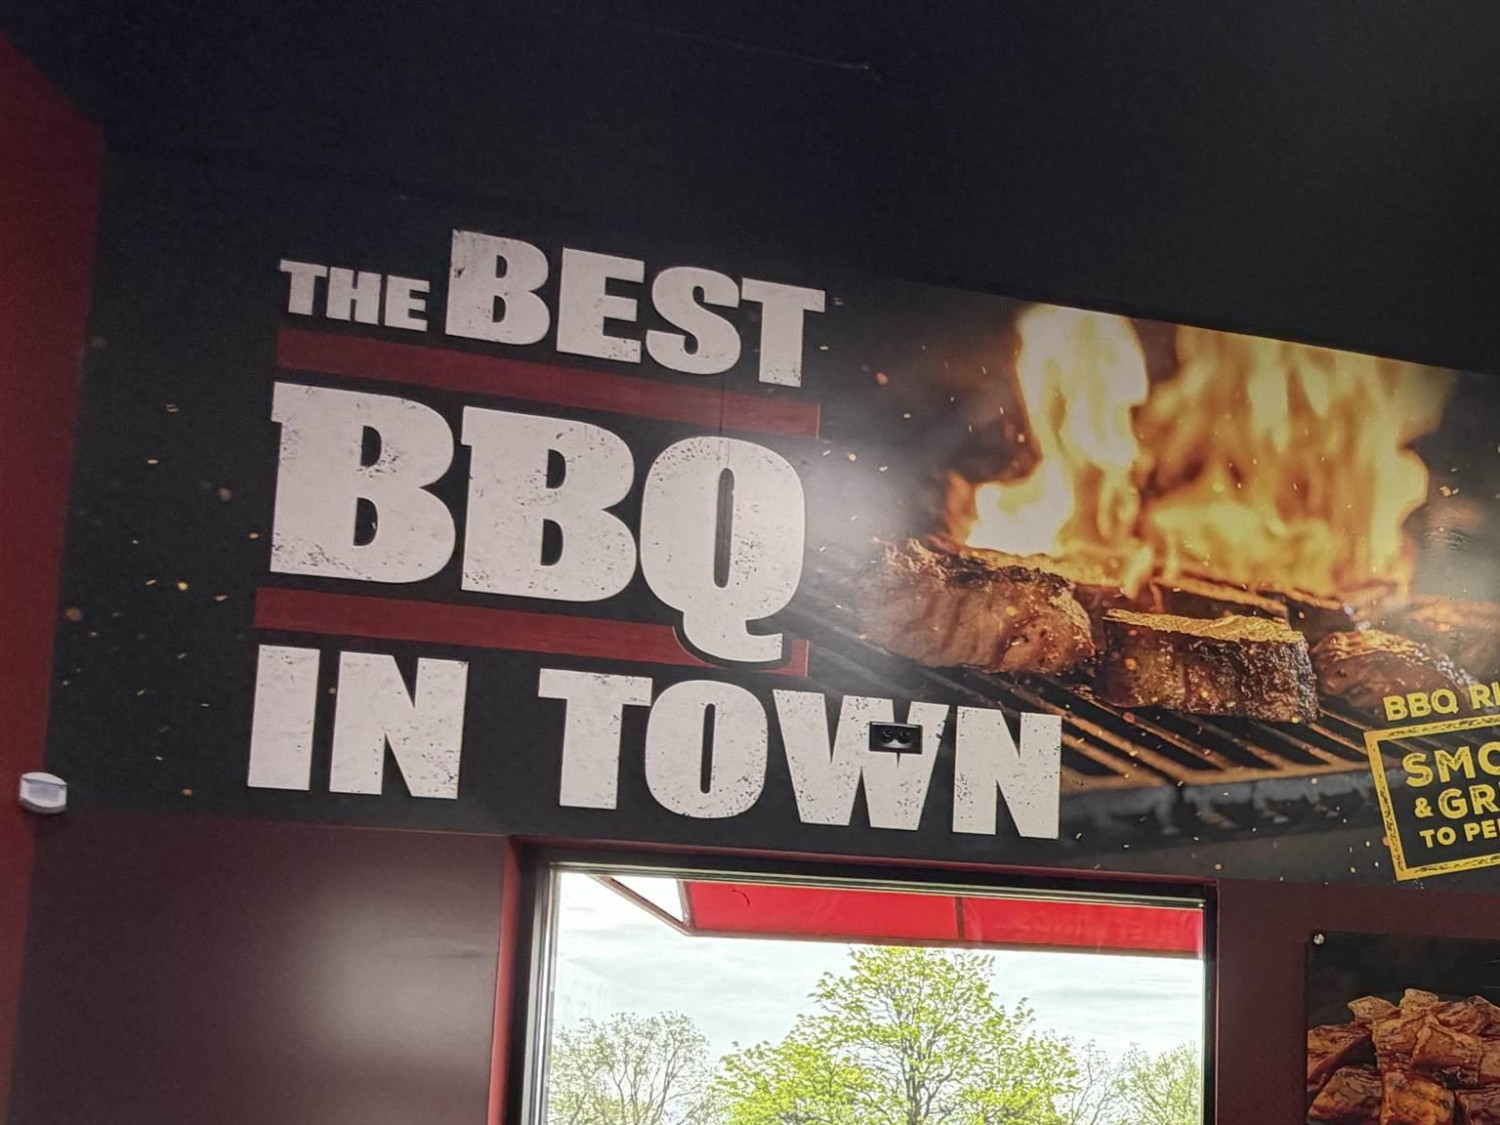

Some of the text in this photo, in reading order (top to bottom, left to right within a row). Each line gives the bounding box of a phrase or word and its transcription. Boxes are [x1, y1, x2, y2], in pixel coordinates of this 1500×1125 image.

[280, 229, 825, 387] THE BEST
[270, 382, 806, 663] BBQ
[247, 645, 1062, 840] IN TOWN
[1383, 690, 1459, 721] BBQ
[1419, 826, 1456, 848] TO
